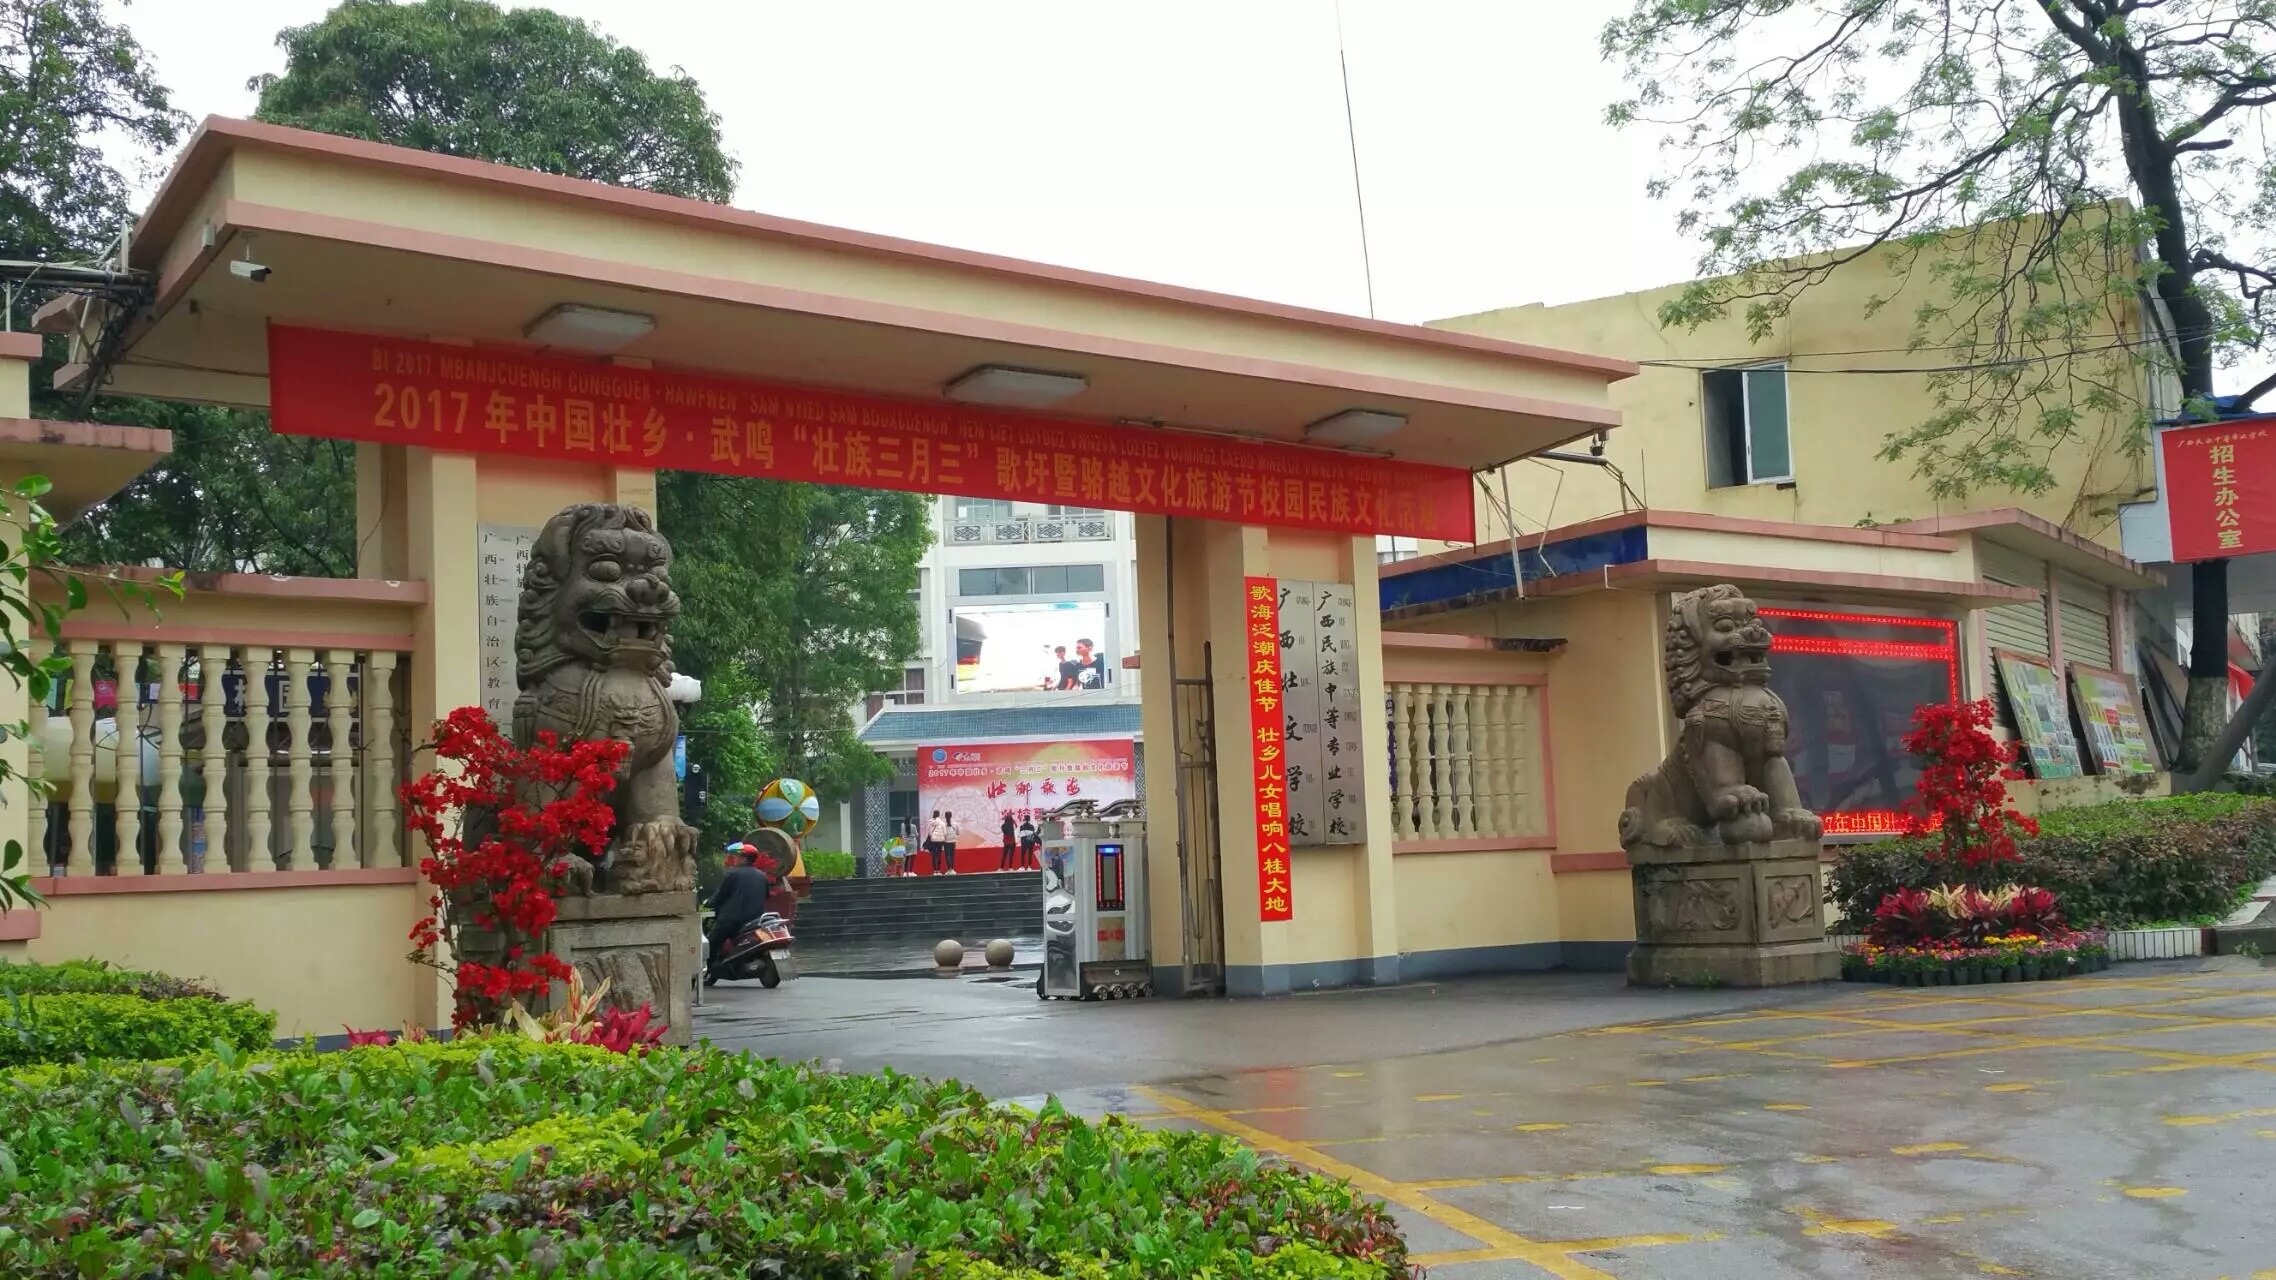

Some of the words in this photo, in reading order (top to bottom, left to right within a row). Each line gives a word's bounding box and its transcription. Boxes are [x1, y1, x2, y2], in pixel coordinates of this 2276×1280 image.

[371, 348, 388, 371] BI
[396, 351, 432, 377] 2017
[440, 356, 562, 391] MBANJCUENGH
[2209, 444, 2243, 549] 招生办公室
[484, 531, 502, 722] 广西壮族自治区教育
[1249, 583, 1280, 712] 歌海泛潮庆佳节
[1278, 587, 1309, 836] 广西壮文学校
[1316, 590, 1349, 836] 广西民族中等专业学校
[1256, 727, 1289, 913] 壮乡儿女唱响八桂大地
